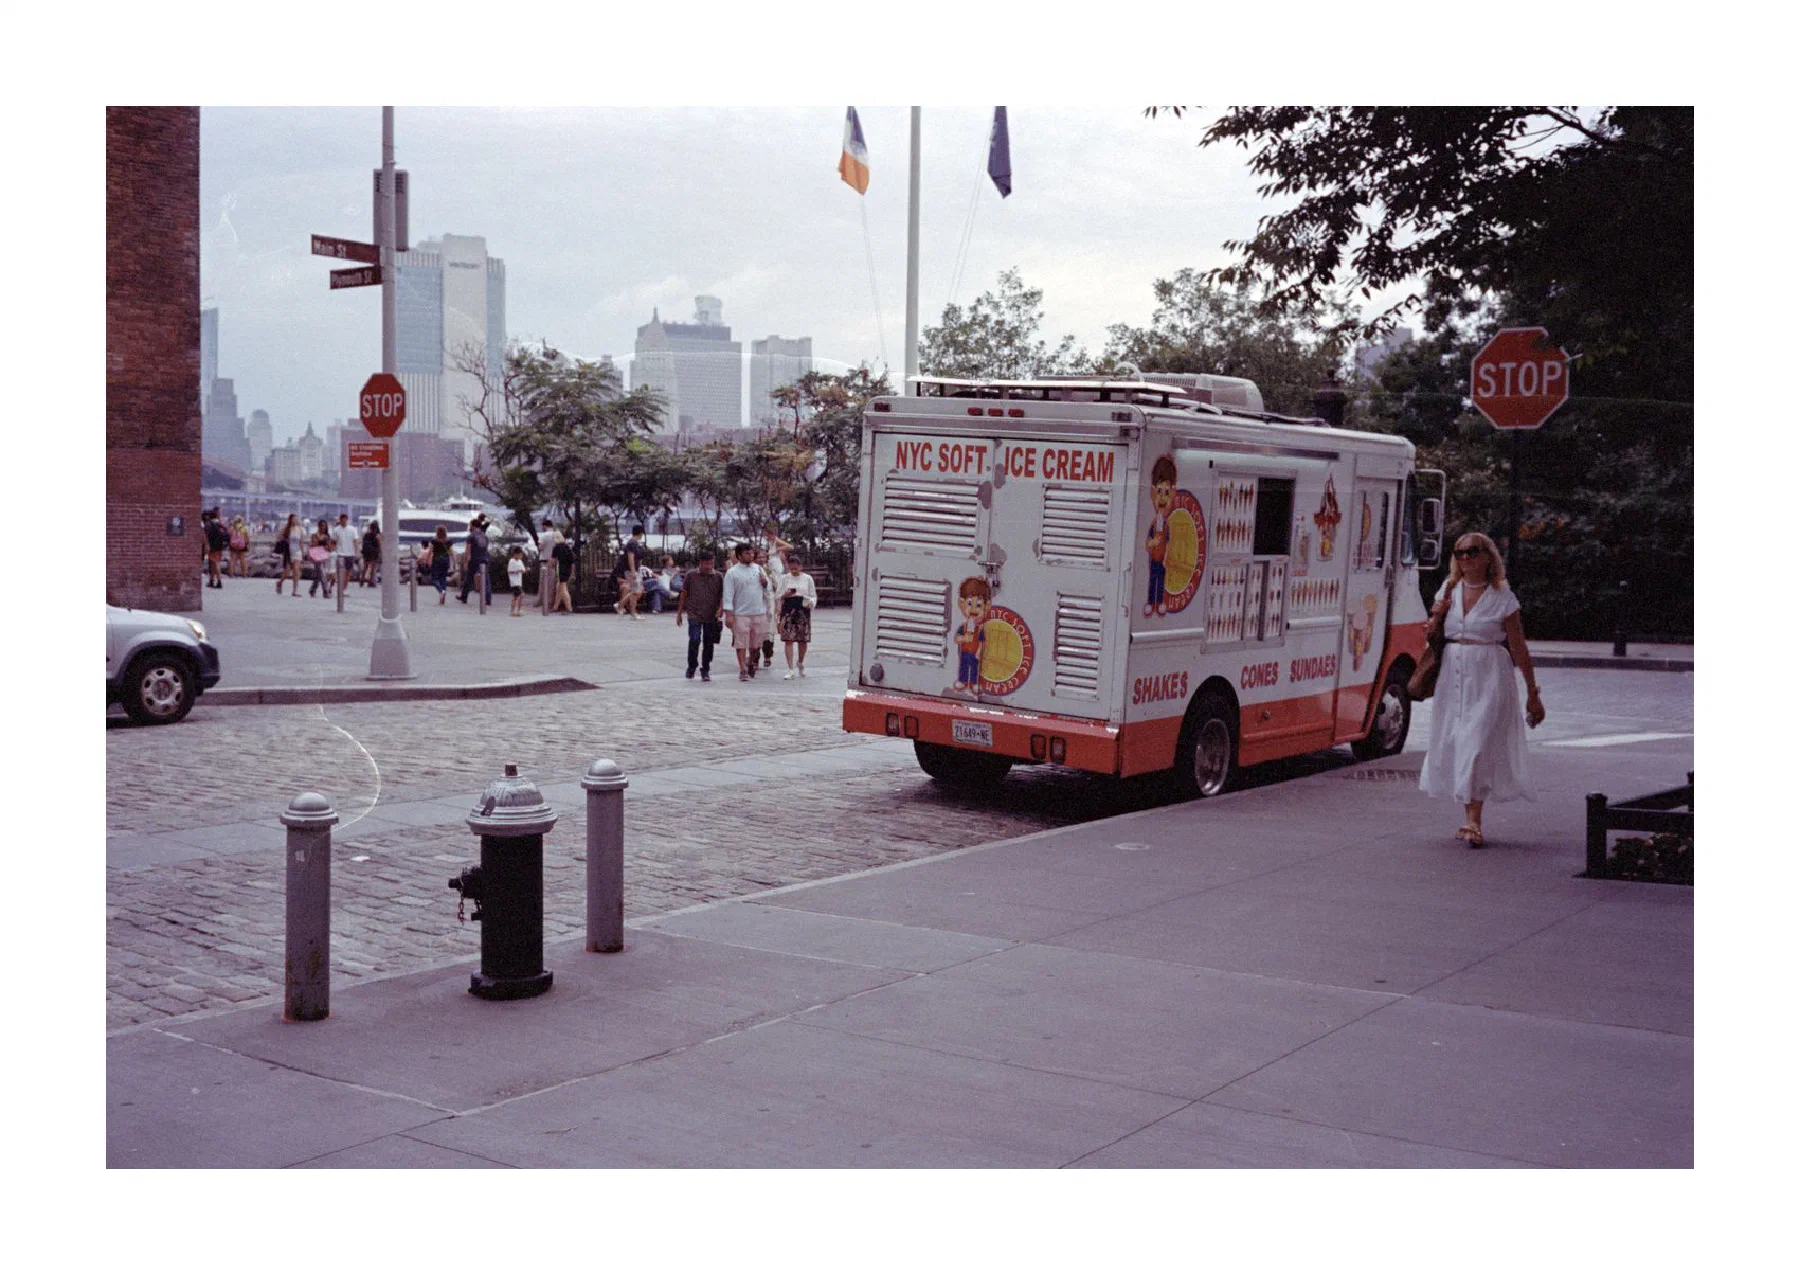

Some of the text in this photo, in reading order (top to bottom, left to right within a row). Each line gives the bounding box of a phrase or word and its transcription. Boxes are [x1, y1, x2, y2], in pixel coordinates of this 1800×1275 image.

[313, 239, 347, 258] Main St
[364, 270, 373, 283] St
[1477, 359, 1562, 398] STOP
[362, 393, 403, 418] STOP
[896, 441, 1115, 483] NYC SOFT ICE CREAM
[1011, 618, 1032, 648] SOFT
[1133, 653, 1336, 705] SHAKES CONES SUNDAES
